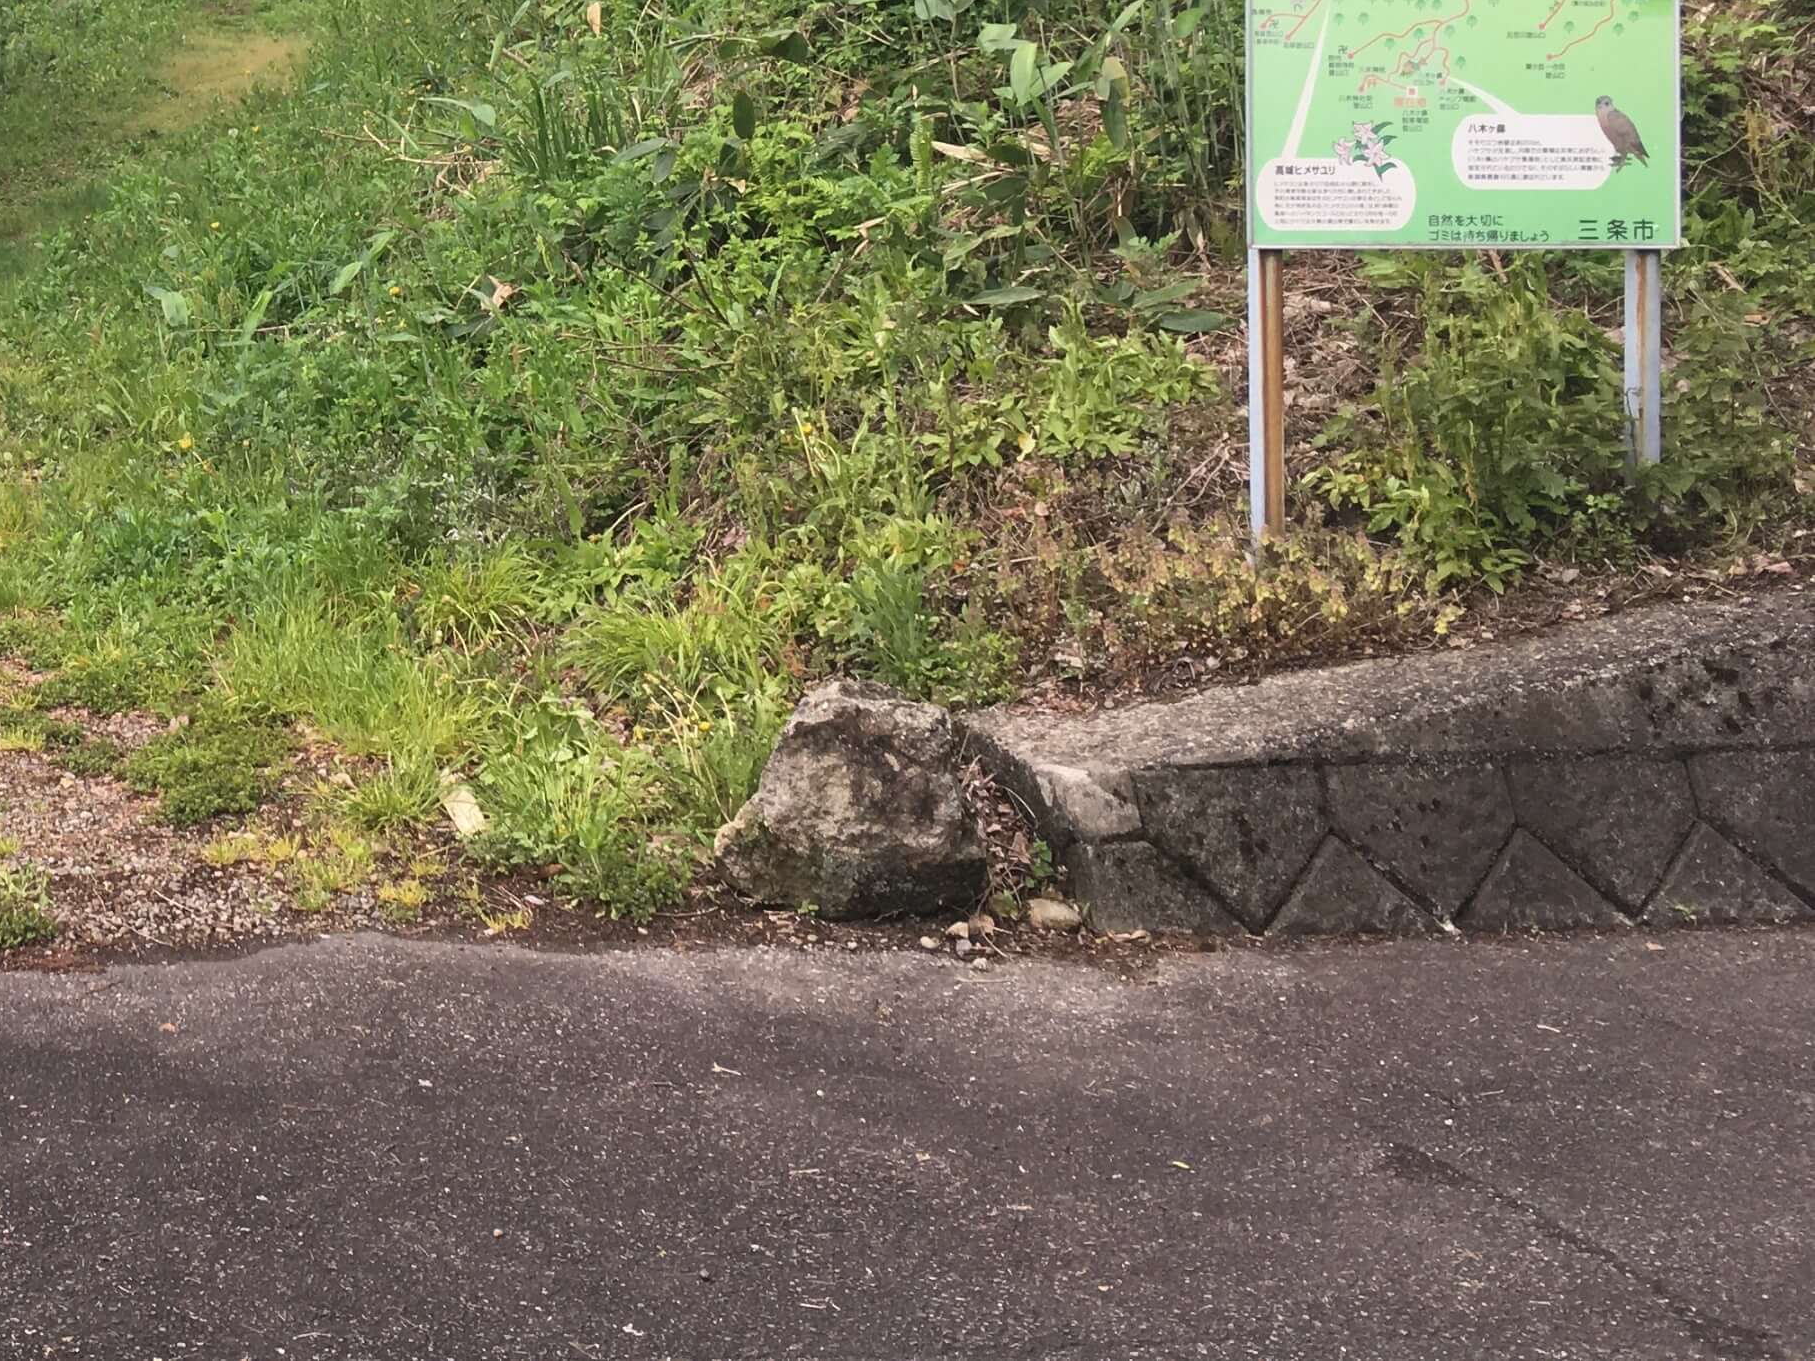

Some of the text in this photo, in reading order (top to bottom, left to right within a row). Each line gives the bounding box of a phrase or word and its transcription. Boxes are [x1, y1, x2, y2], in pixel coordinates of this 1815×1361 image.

[1275, 165, 1336, 175] 高城ヒメサユリ
[1428, 215, 1503, 227] 自然を大切に
[1428, 230, 1550, 242] ゴミは持ち帰りましょう
[1578, 219, 1654, 241] 三条市
